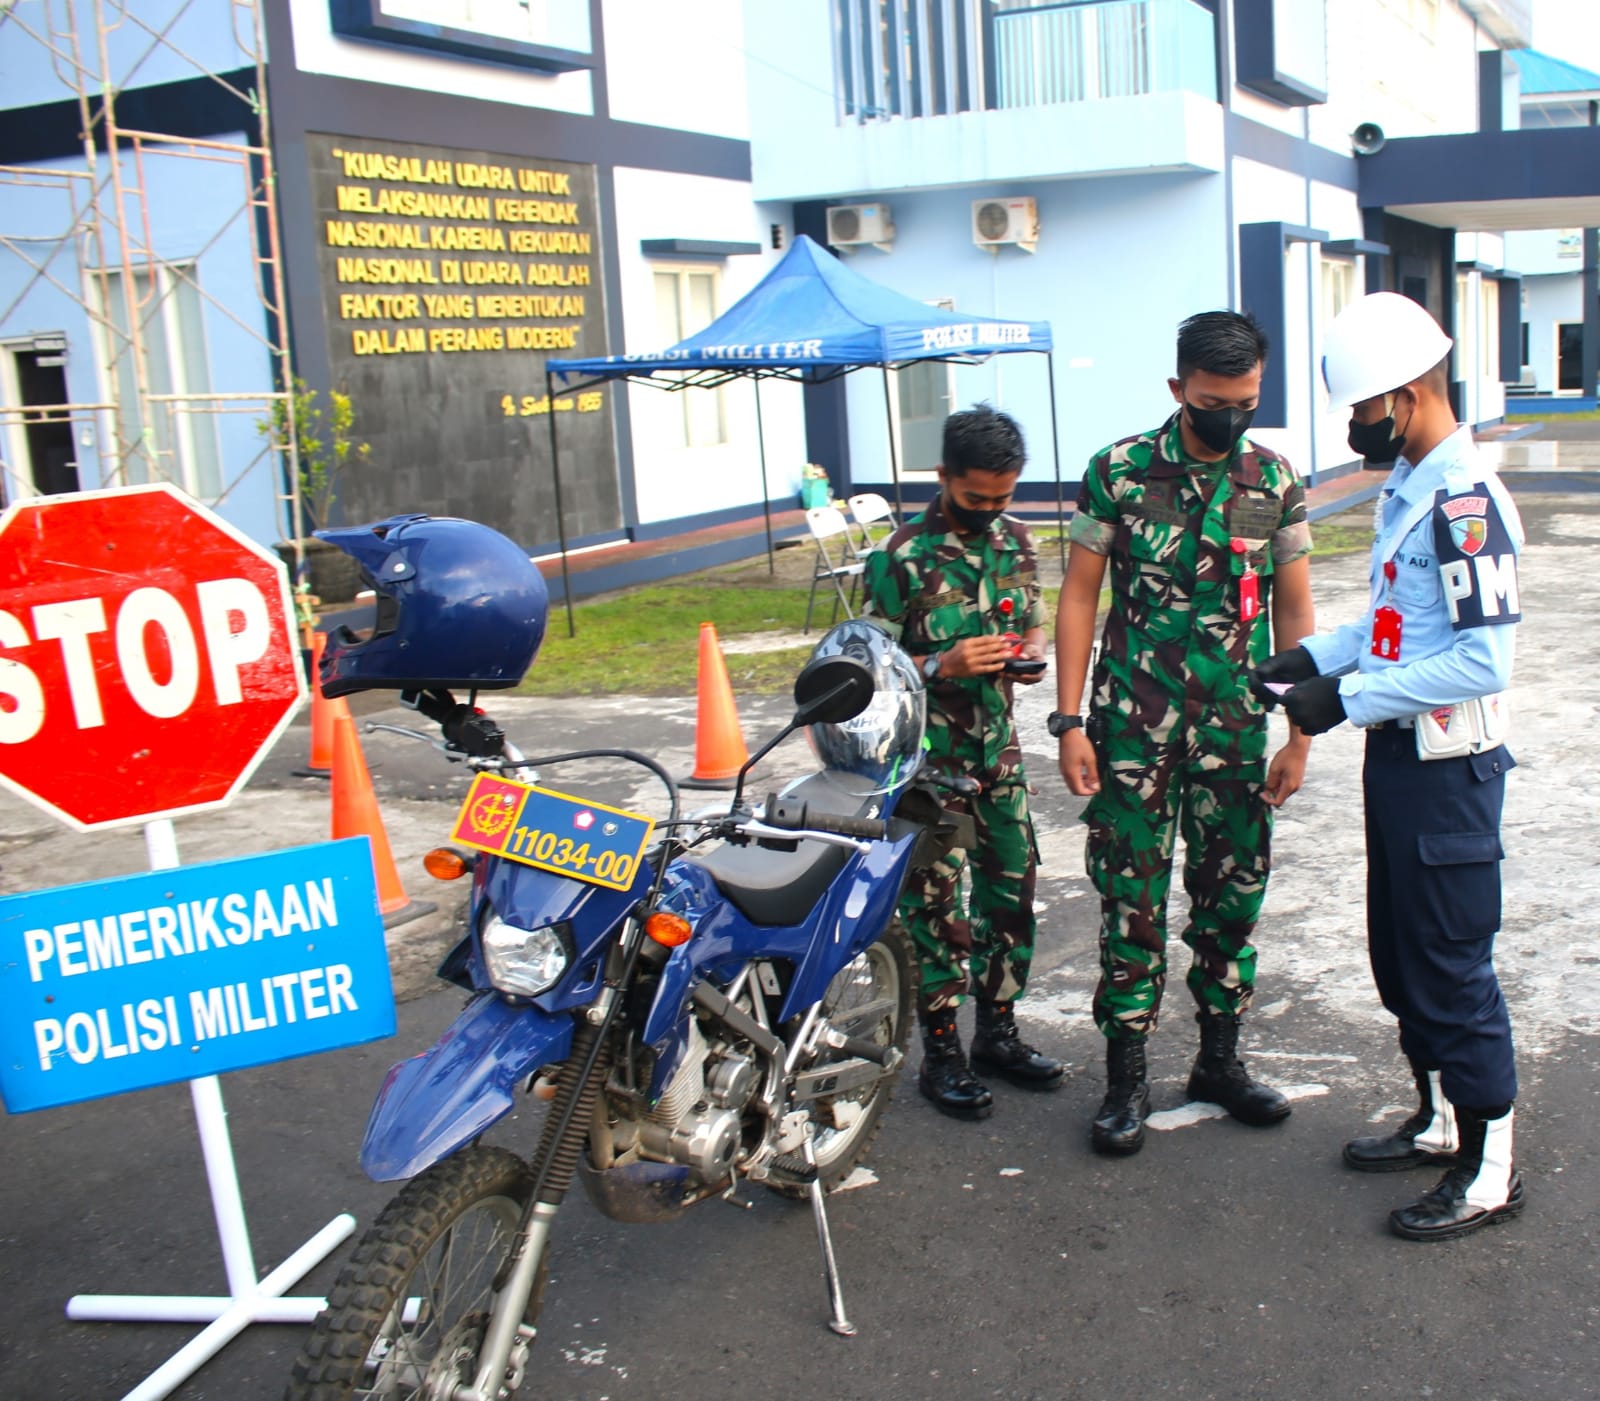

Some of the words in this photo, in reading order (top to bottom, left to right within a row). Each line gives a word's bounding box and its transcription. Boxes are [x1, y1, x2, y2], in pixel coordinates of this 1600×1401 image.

[456, 162, 516, 191] UDARA
[518, 168, 571, 195] UNTUK
[336, 185, 491, 220] MELAKSANAKAN
[495, 198, 580, 225] KEHENDAK
[326, 221, 430, 249] NASIONAL
[430, 226, 506, 251] KARENA
[509, 230, 591, 254] KEKUATAN
[337, 257, 438, 284] NASIONAL
[441, 260, 460, 283] DI
[463, 261, 524, 285] UDARA
[527, 263, 591, 286] ADALAH
[340, 293, 421, 320] FAKTOR
[423, 294, 474, 319] YANG
[477, 295, 585, 318] MENENTUKAN
[353, 328, 426, 355] DALAM
[430, 327, 504, 352] PERANG
[701, 339, 825, 360] MILITER
[921, 323, 974, 351] POLISI
[977, 322, 1031, 344] MILITER
[1409, 556, 1429, 568] AU
[1440, 554, 1520, 623] PM
[0, 578, 271, 744] STOP
[513, 826, 634, 882] 11034-00
[23, 878, 338, 982] PEMERIKSAAN
[34, 996, 182, 1072] POLISI
[189, 963, 359, 1041] MILITER
